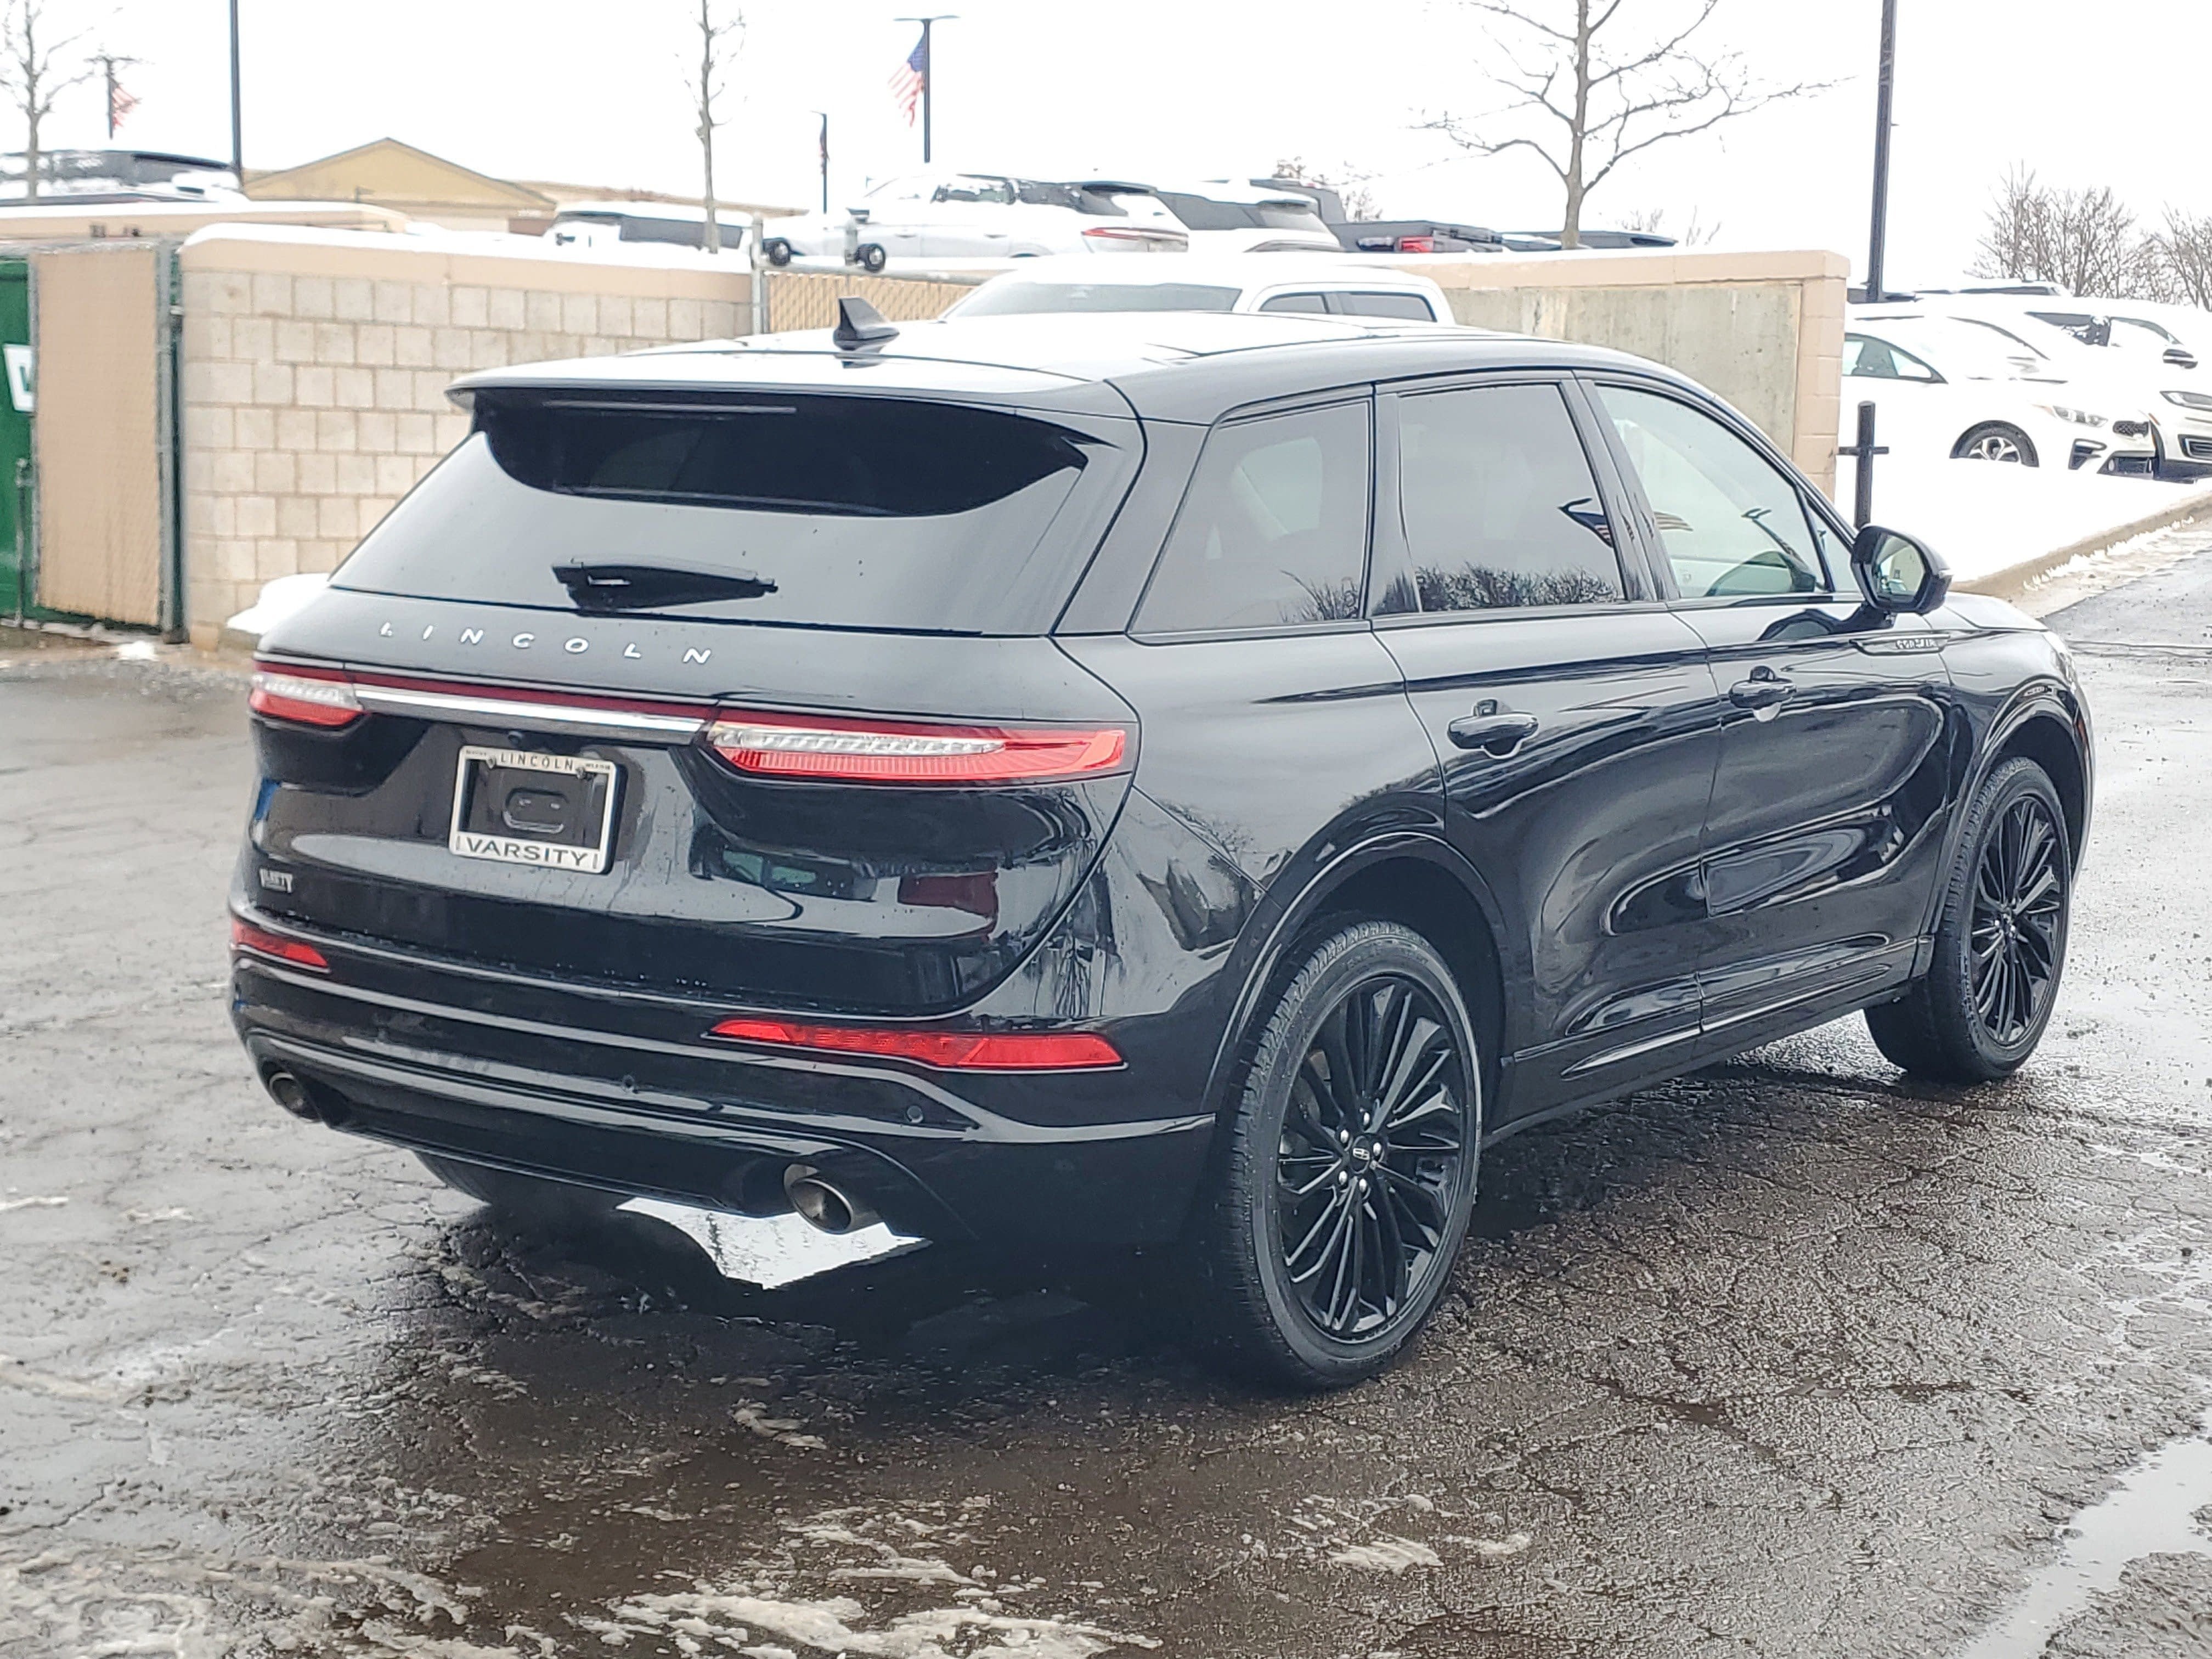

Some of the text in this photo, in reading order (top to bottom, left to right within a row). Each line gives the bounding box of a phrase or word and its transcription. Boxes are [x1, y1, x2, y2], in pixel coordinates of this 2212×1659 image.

[379, 622, 713, 664] LINCOLN
[501, 752, 573, 771] LINCOLN
[467, 837, 588, 866] VARSITY
